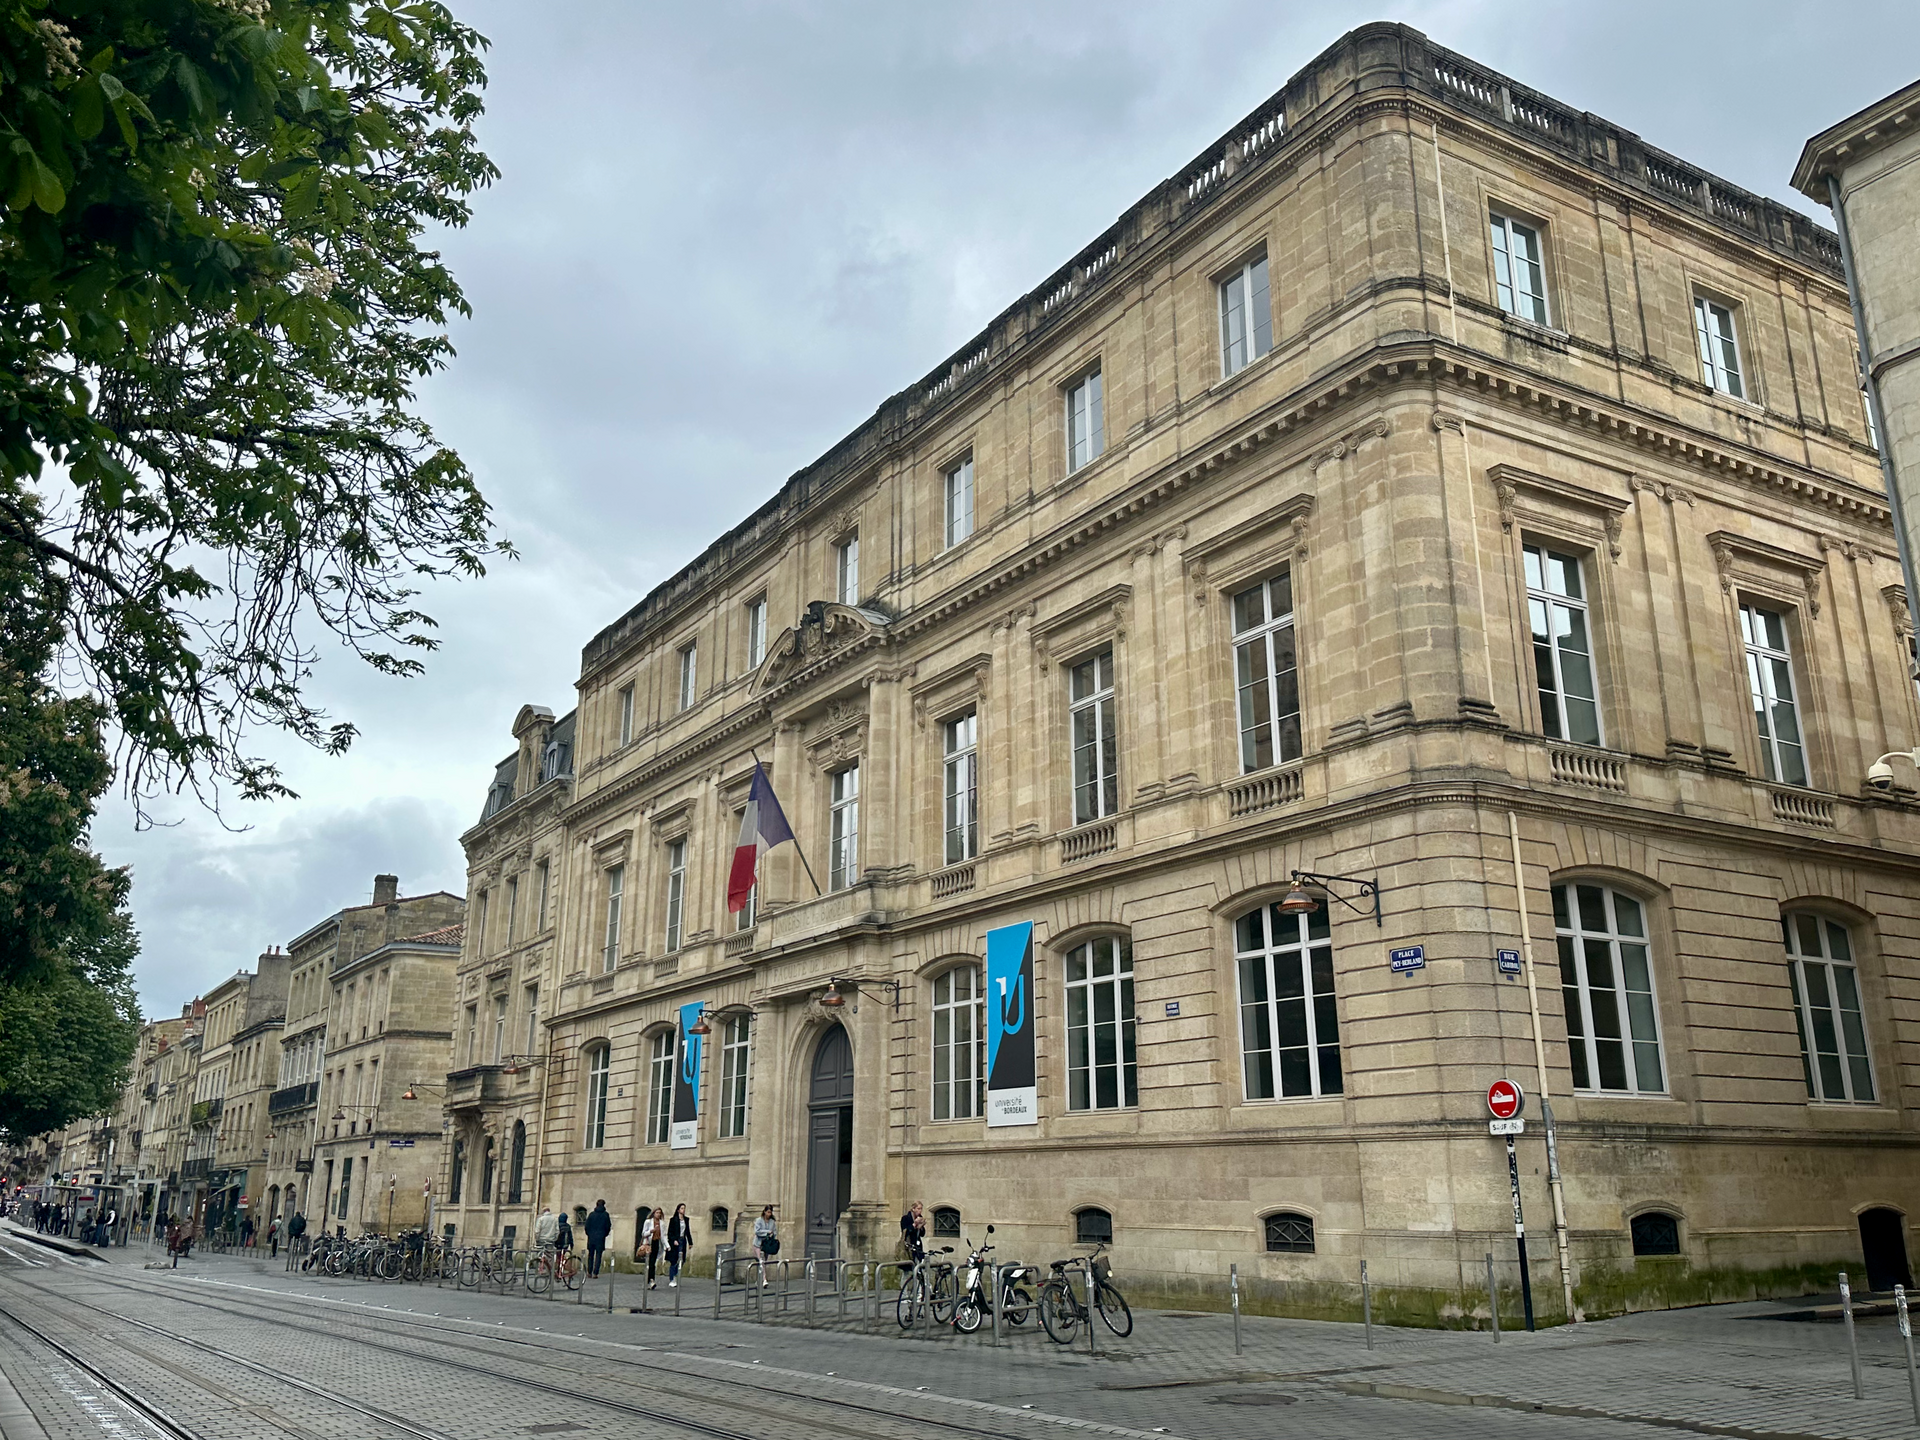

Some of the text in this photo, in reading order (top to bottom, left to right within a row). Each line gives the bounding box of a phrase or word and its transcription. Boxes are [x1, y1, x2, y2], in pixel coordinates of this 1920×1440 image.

[1398, 949, 1415, 958] PLACE
[1503, 952, 1516, 961] RUE
[1392, 957, 1422, 968] PEY-BERLAND
[994, 1095, 1022, 1107] université
[1003, 1105, 1027, 1115] BORDEAUX
